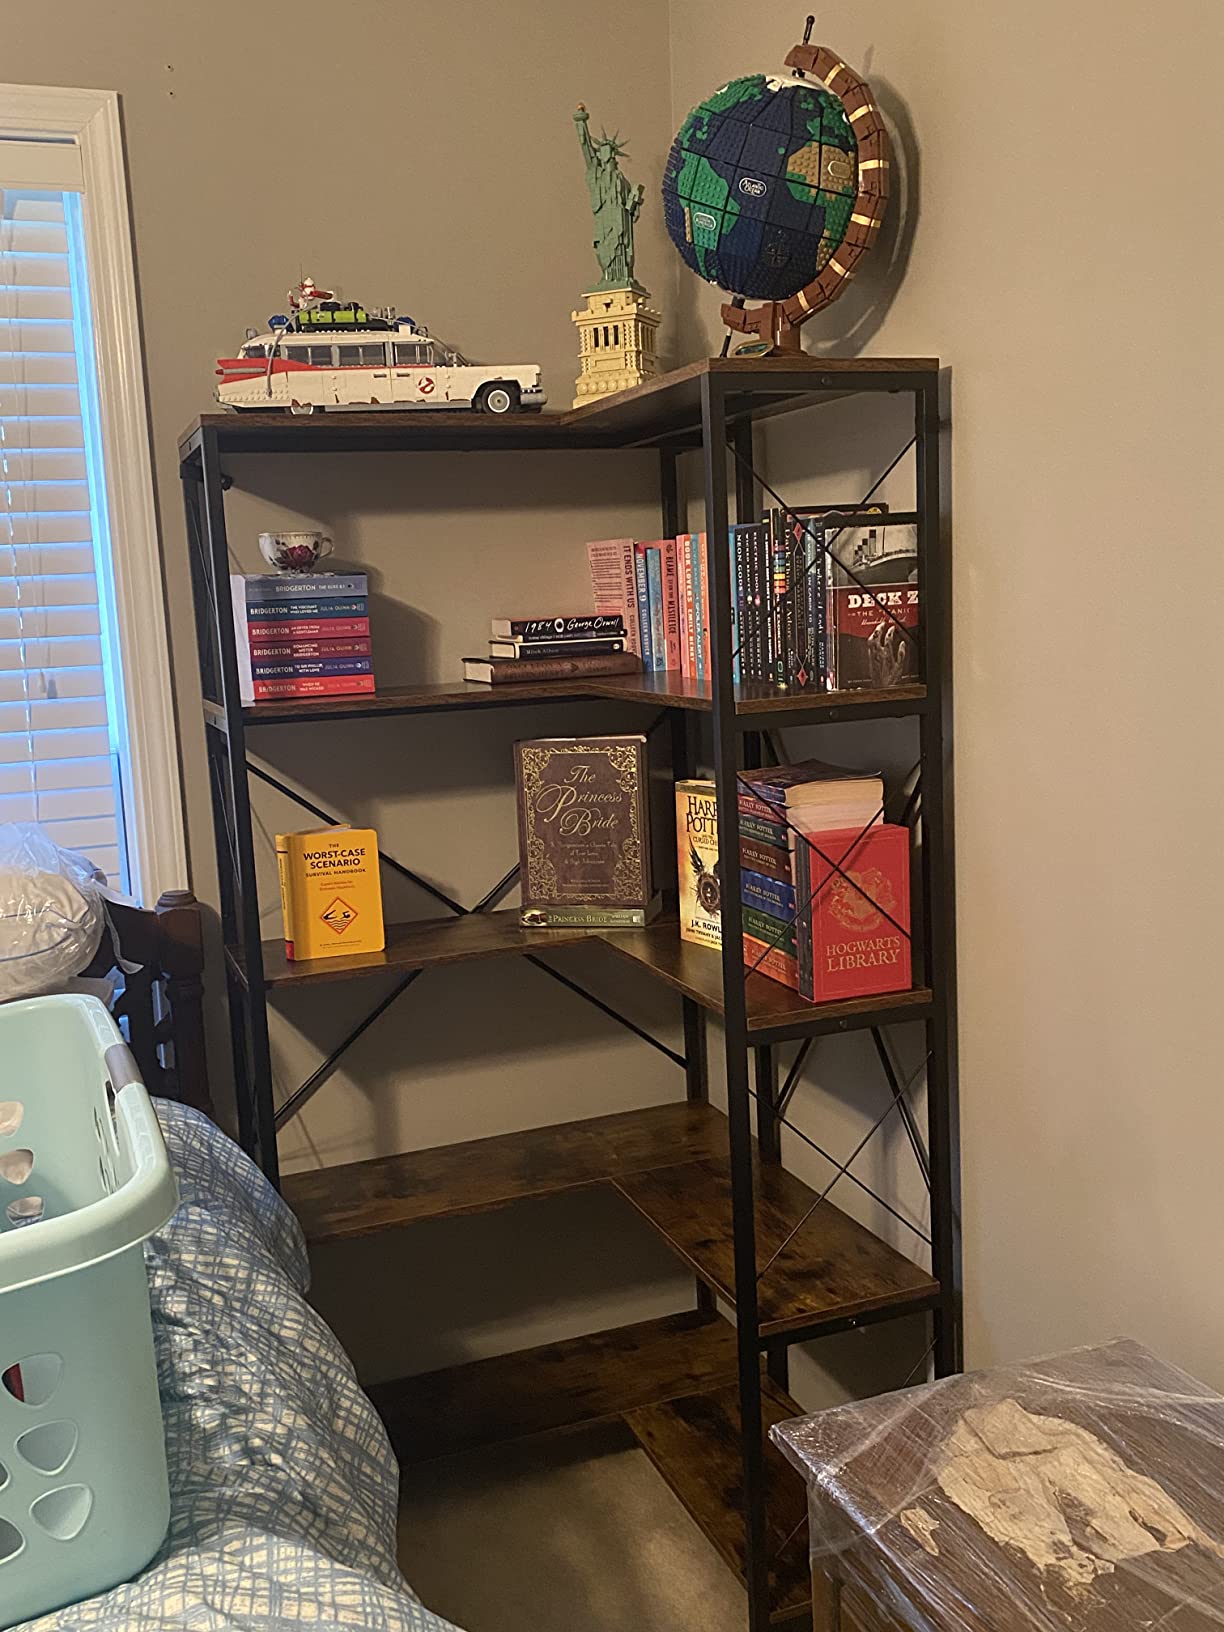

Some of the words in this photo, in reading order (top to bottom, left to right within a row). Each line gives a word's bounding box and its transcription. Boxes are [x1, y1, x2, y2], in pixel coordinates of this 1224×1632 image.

[624, 554, 633, 575] ENDS
[636, 553, 646, 592] NOVEMBER
[666, 556, 675, 576] BLAME
[275, 584, 316, 593] BRIDGERTON
[625, 576, 634, 595] WITH
[685, 568, 693, 602] LOVERS
[627, 598, 635, 608] US
[639, 594, 647, 602] 9
[847, 591, 902, 609] DECK
[907, 590, 919, 605] Z
[250, 607, 288, 615] BRIDGERTON
[252, 627, 289, 636] BRIDGERTON
[525, 620, 552, 633] 1984
[566, 618, 593, 631] George
[593, 616, 620, 629] Orwell
[253, 648, 291, 656] BRIDGERTON
[255, 666, 293, 675] BRIDGERTON
[258, 685, 296, 693] BRIDGERTON
[563, 765, 596, 784] The
[535, 783, 623, 823] Princess
[687, 795, 718, 818] HARR
[559, 807, 619, 836] Bride
[686, 812, 718, 836] POTT
[303, 848, 367, 861] WORST-CASE
[310, 857, 361, 870] SCENARIO
[333, 868, 366, 876] HANDBOOK
[702, 922, 722, 934] ROWL
[826, 936, 901, 957] HOGWARTS
[826, 949, 901, 973] LIBRARY
